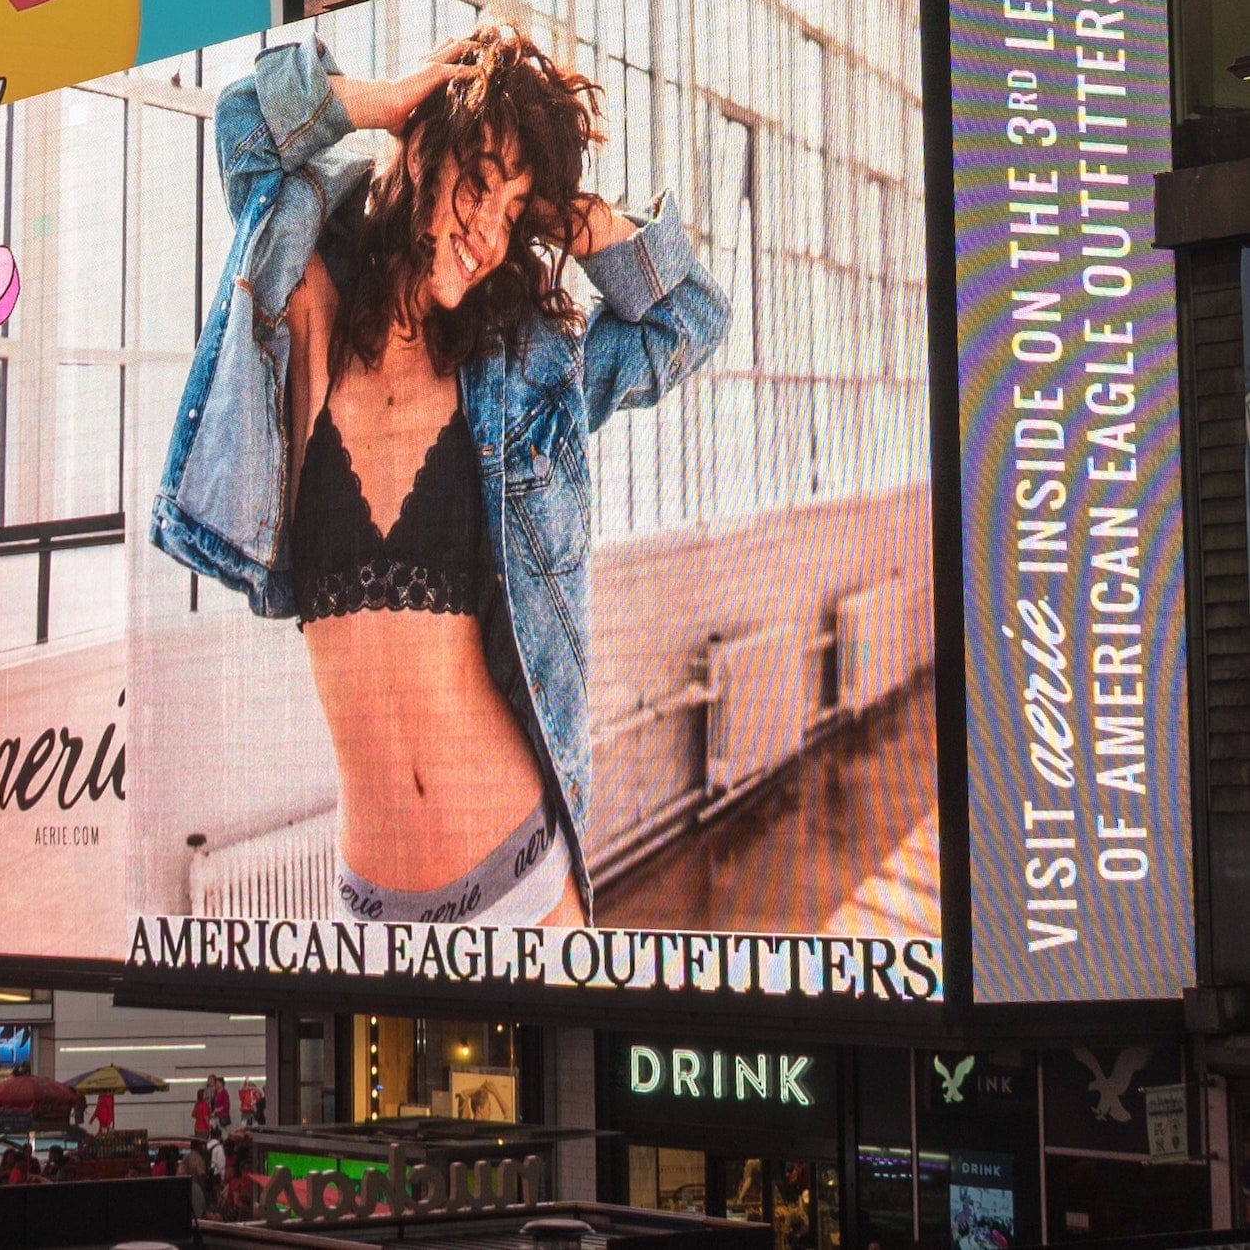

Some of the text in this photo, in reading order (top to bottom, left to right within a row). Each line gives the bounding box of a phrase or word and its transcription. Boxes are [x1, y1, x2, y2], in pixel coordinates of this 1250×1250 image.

[1007, 68, 1058, 147] 3RD
[1007, 166, 1059, 268] THE
[1011, 288, 1063, 364] ON
[1083, 319, 1138, 484] EAGLE
[1013, 384, 1068, 574] INSIDE
[1088, 506, 1147, 795] AMERICAN
[34, 826, 100, 846] AERIE.COM
[514, 826, 548, 879] aer
[1096, 814, 1149, 882] OF
[1024, 800, 1077, 953] VISIT
[126, 915, 939, 1002] AMERICAN EAGLE OUTFITTERS
[629, 1044, 812, 1106] DRINK
[976, 1075, 1013, 1094] INK
[961, 1161, 1001, 1177] DRINK
